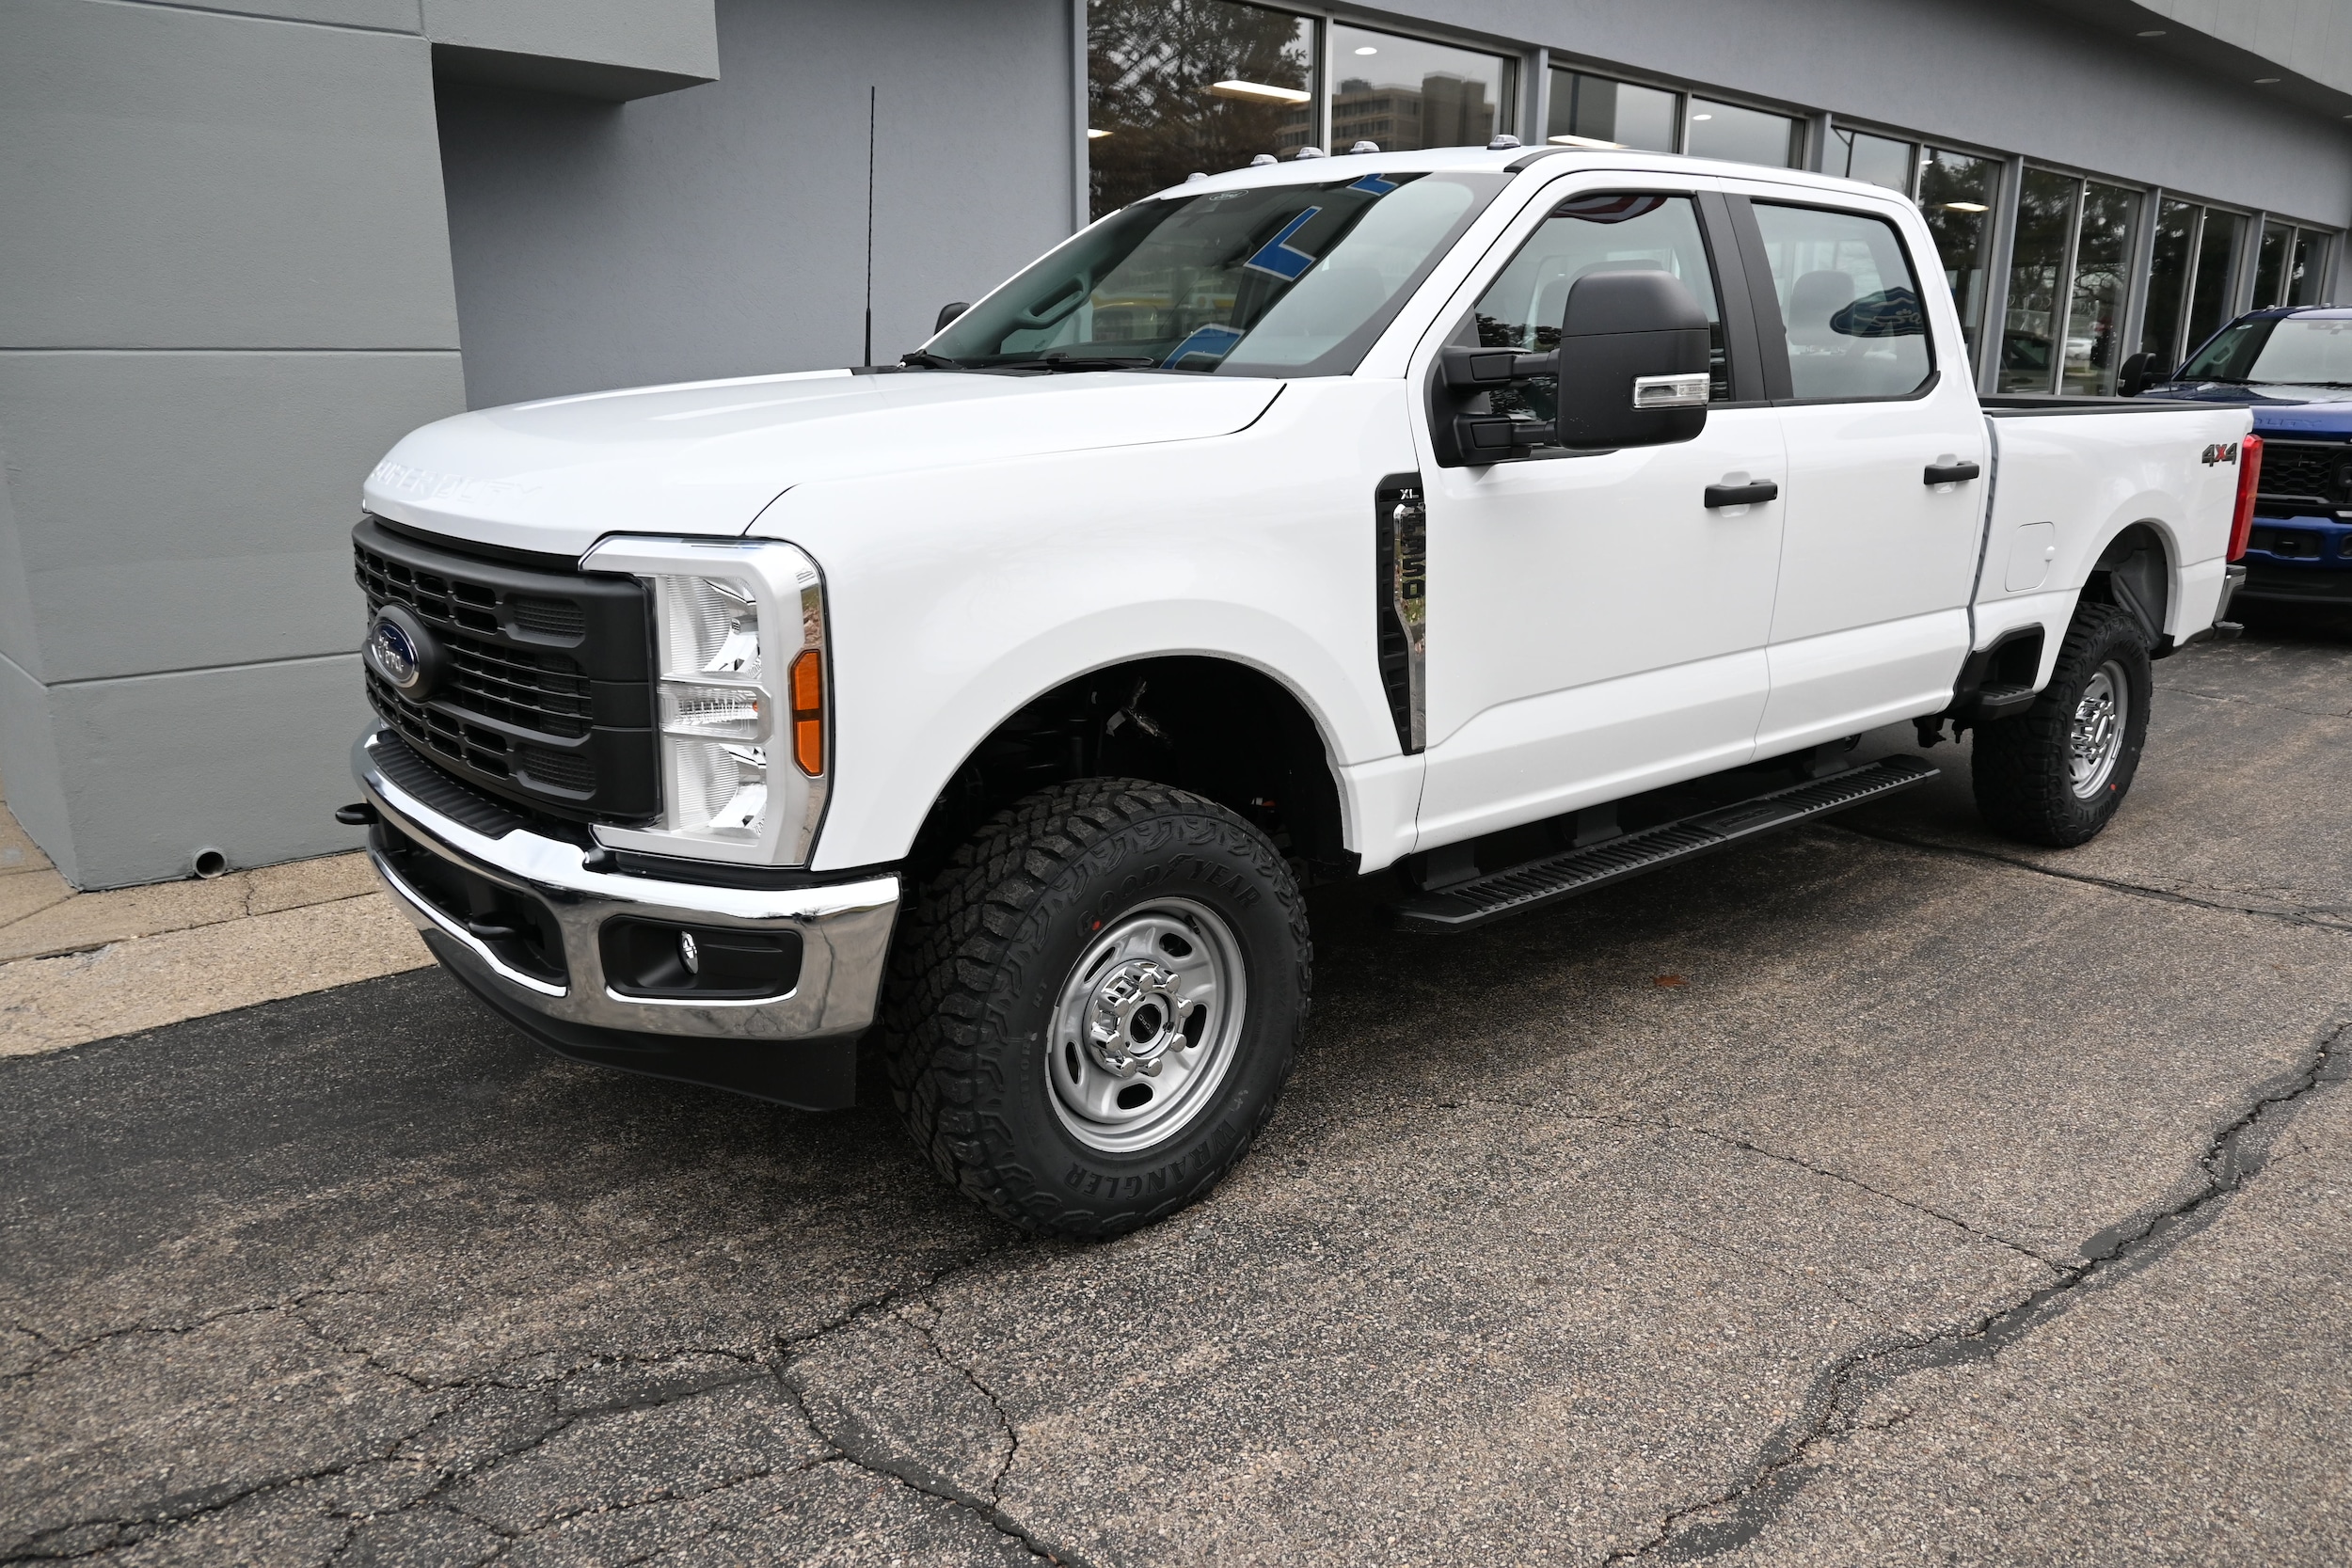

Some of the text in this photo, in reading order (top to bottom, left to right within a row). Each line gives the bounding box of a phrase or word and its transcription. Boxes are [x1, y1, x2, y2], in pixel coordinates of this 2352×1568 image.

[371, 461, 545, 508] SUPER DUTY
[1399, 488, 1420, 500] XL
[1075, 851, 1262, 938] GOODYEAR
[1065, 1117, 1239, 1201] WRANGLER
